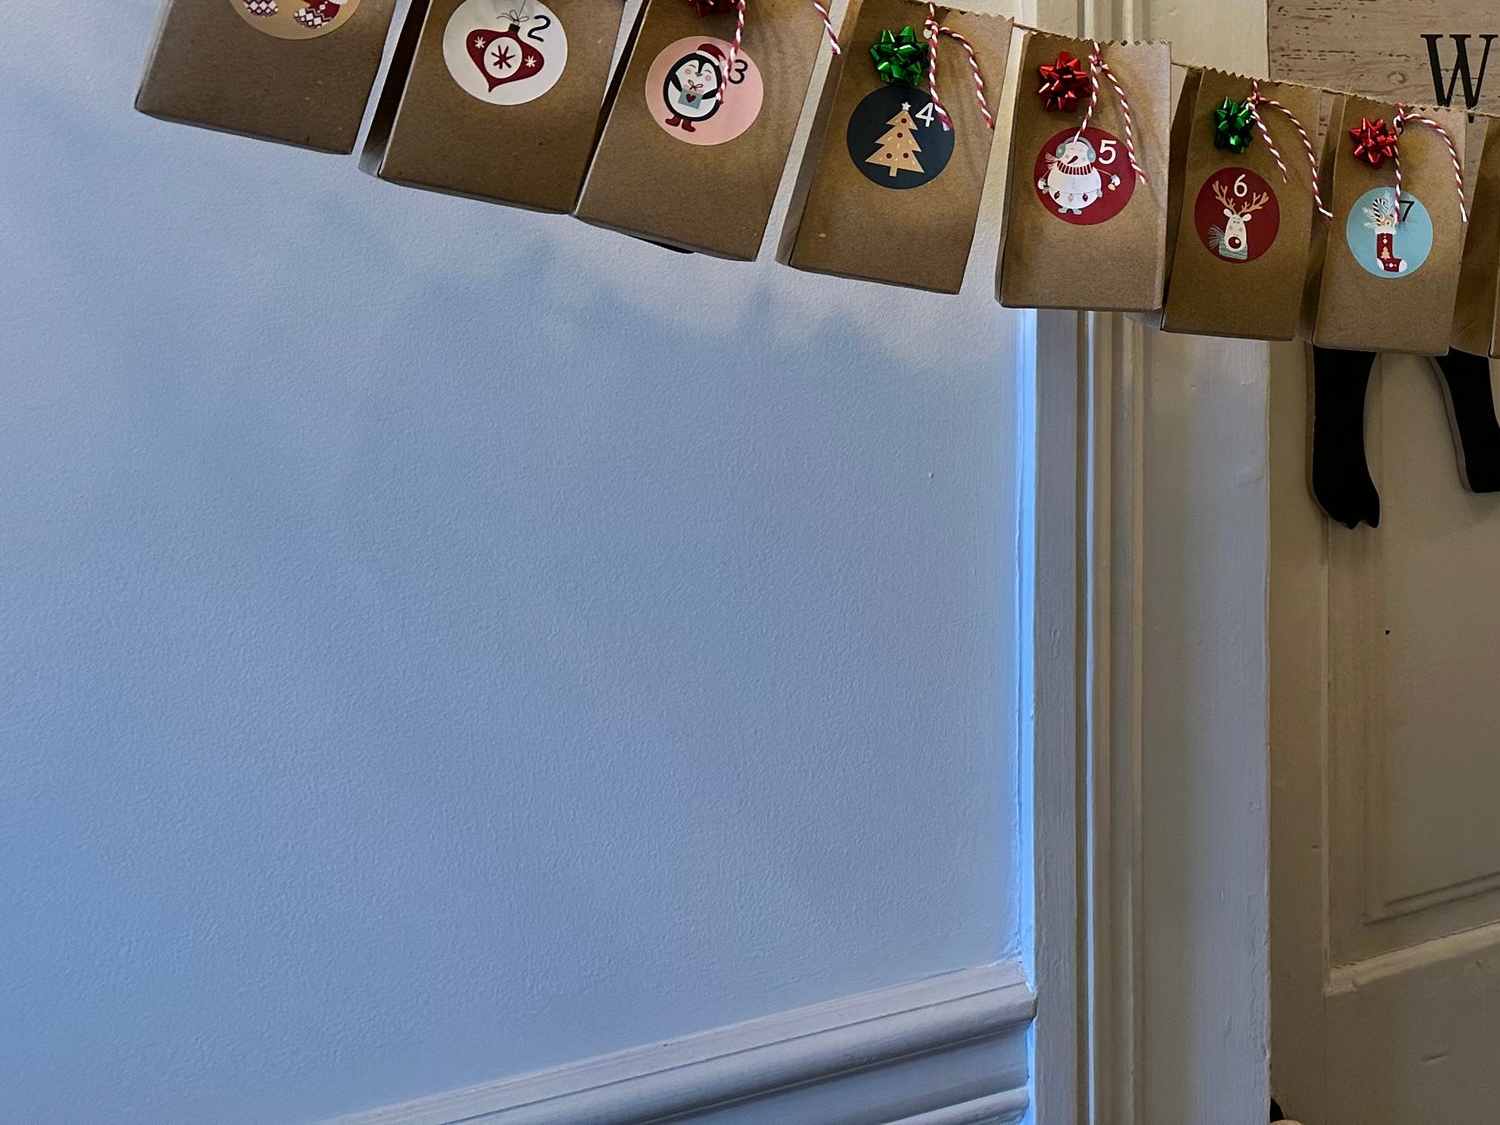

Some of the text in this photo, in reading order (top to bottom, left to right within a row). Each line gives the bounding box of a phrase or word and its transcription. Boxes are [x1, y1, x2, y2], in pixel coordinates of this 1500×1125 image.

[527, 14, 550, 43] 2
[728, 59, 748, 84] 3
[916, 102, 935, 127] 4
[1098, 139, 1117, 164] 5
[1233, 174, 1248, 197] 6
[1398, 199, 1415, 222] 7
